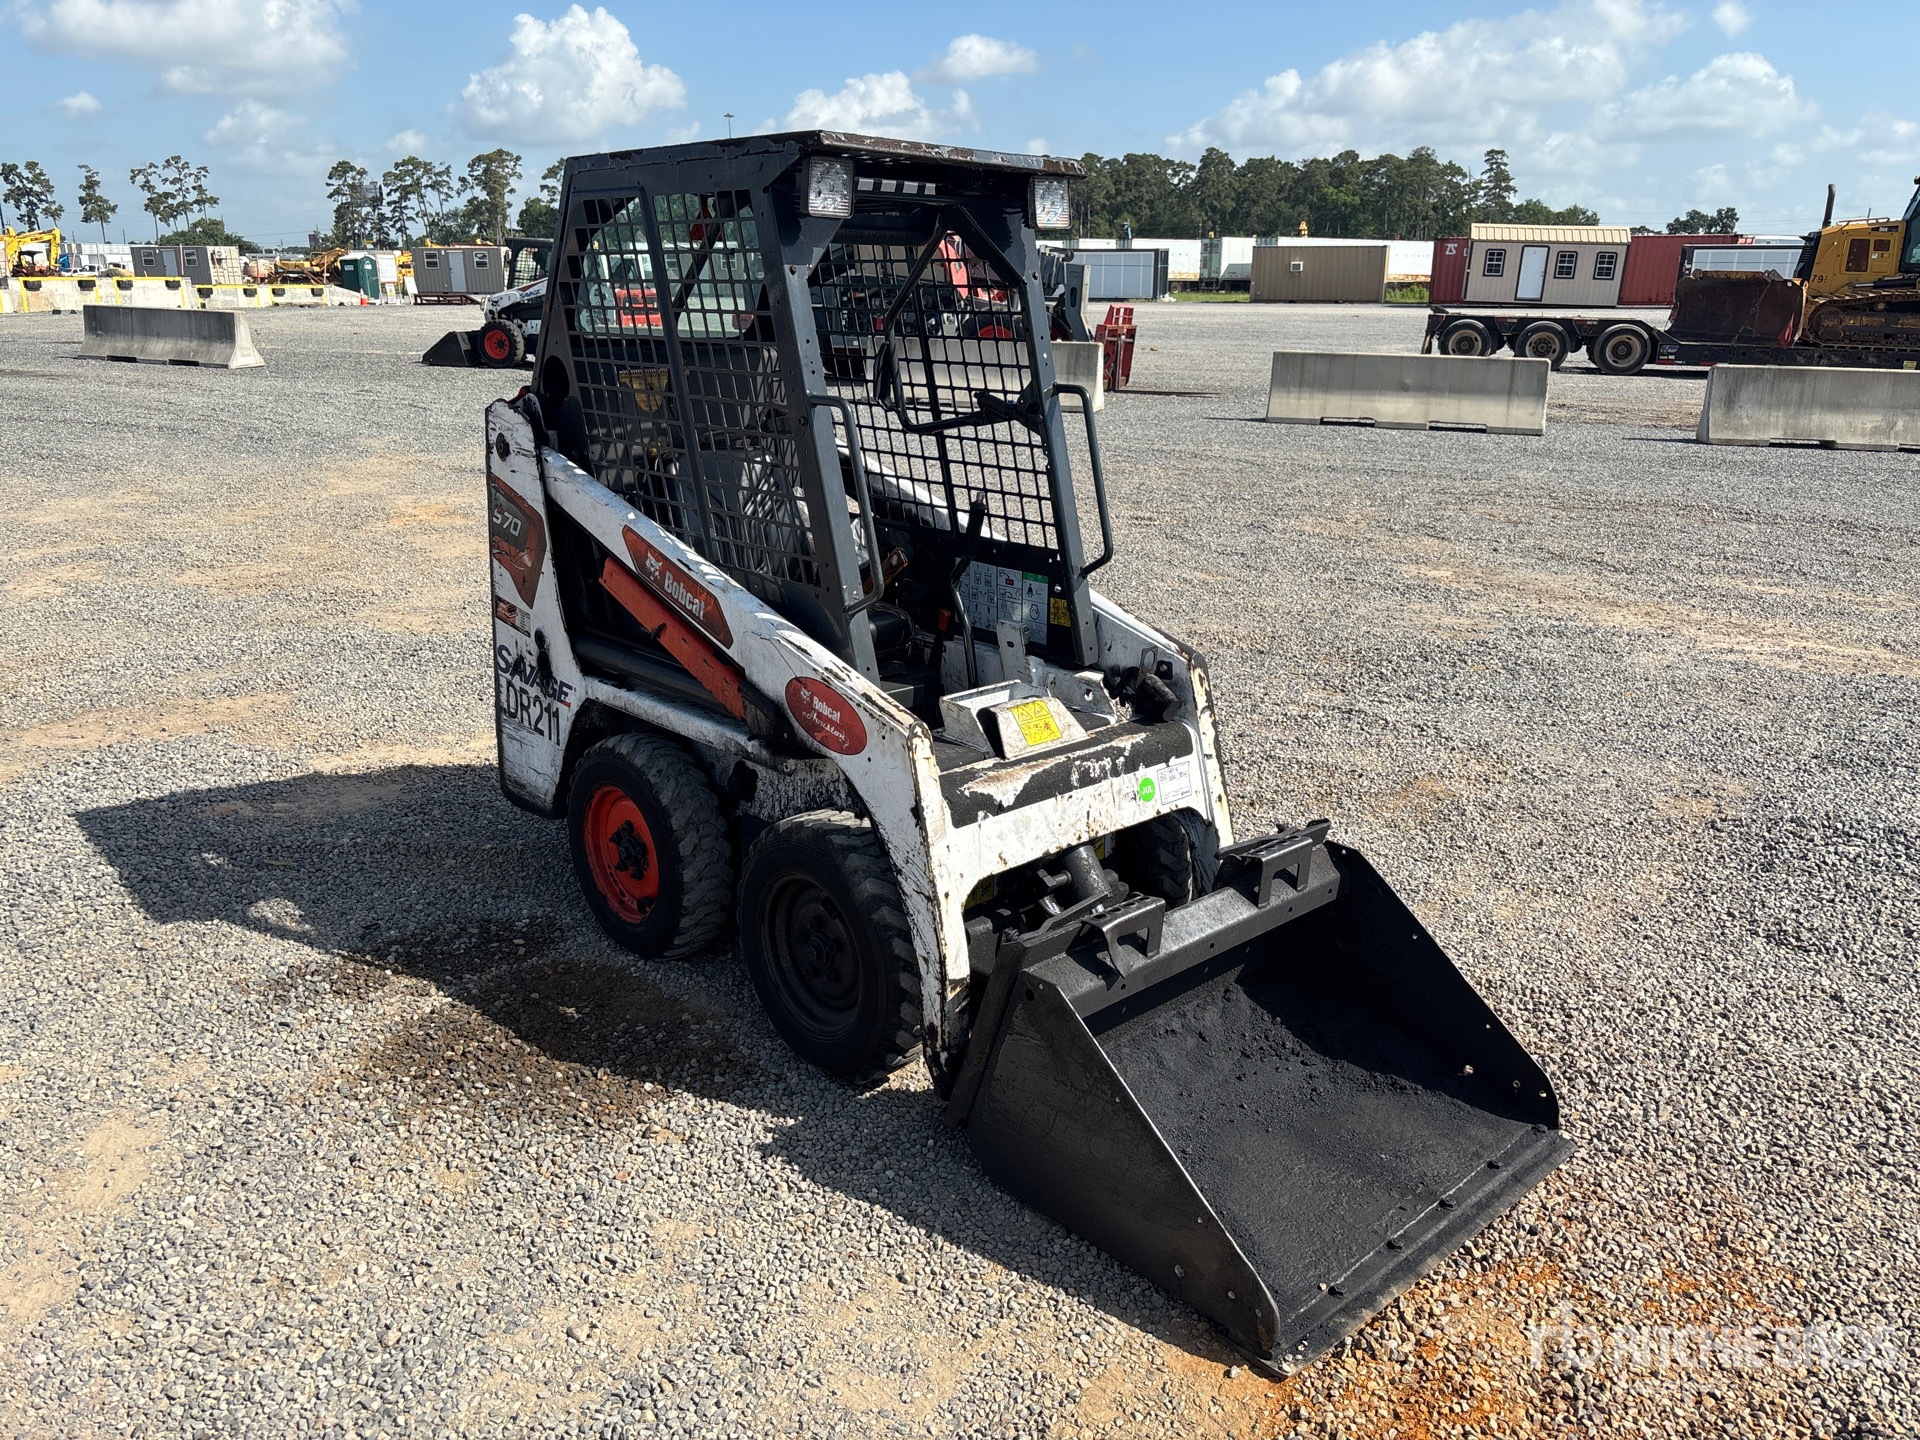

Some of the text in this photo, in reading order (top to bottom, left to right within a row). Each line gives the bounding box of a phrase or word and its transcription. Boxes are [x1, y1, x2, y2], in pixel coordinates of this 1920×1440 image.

[493, 506, 521, 537] S70
[664, 570, 705, 621] Bobcat
[497, 644, 574, 708] SAVAGE
[812, 695, 841, 724] Bobcat
[1141, 785, 1153, 796] JUL
